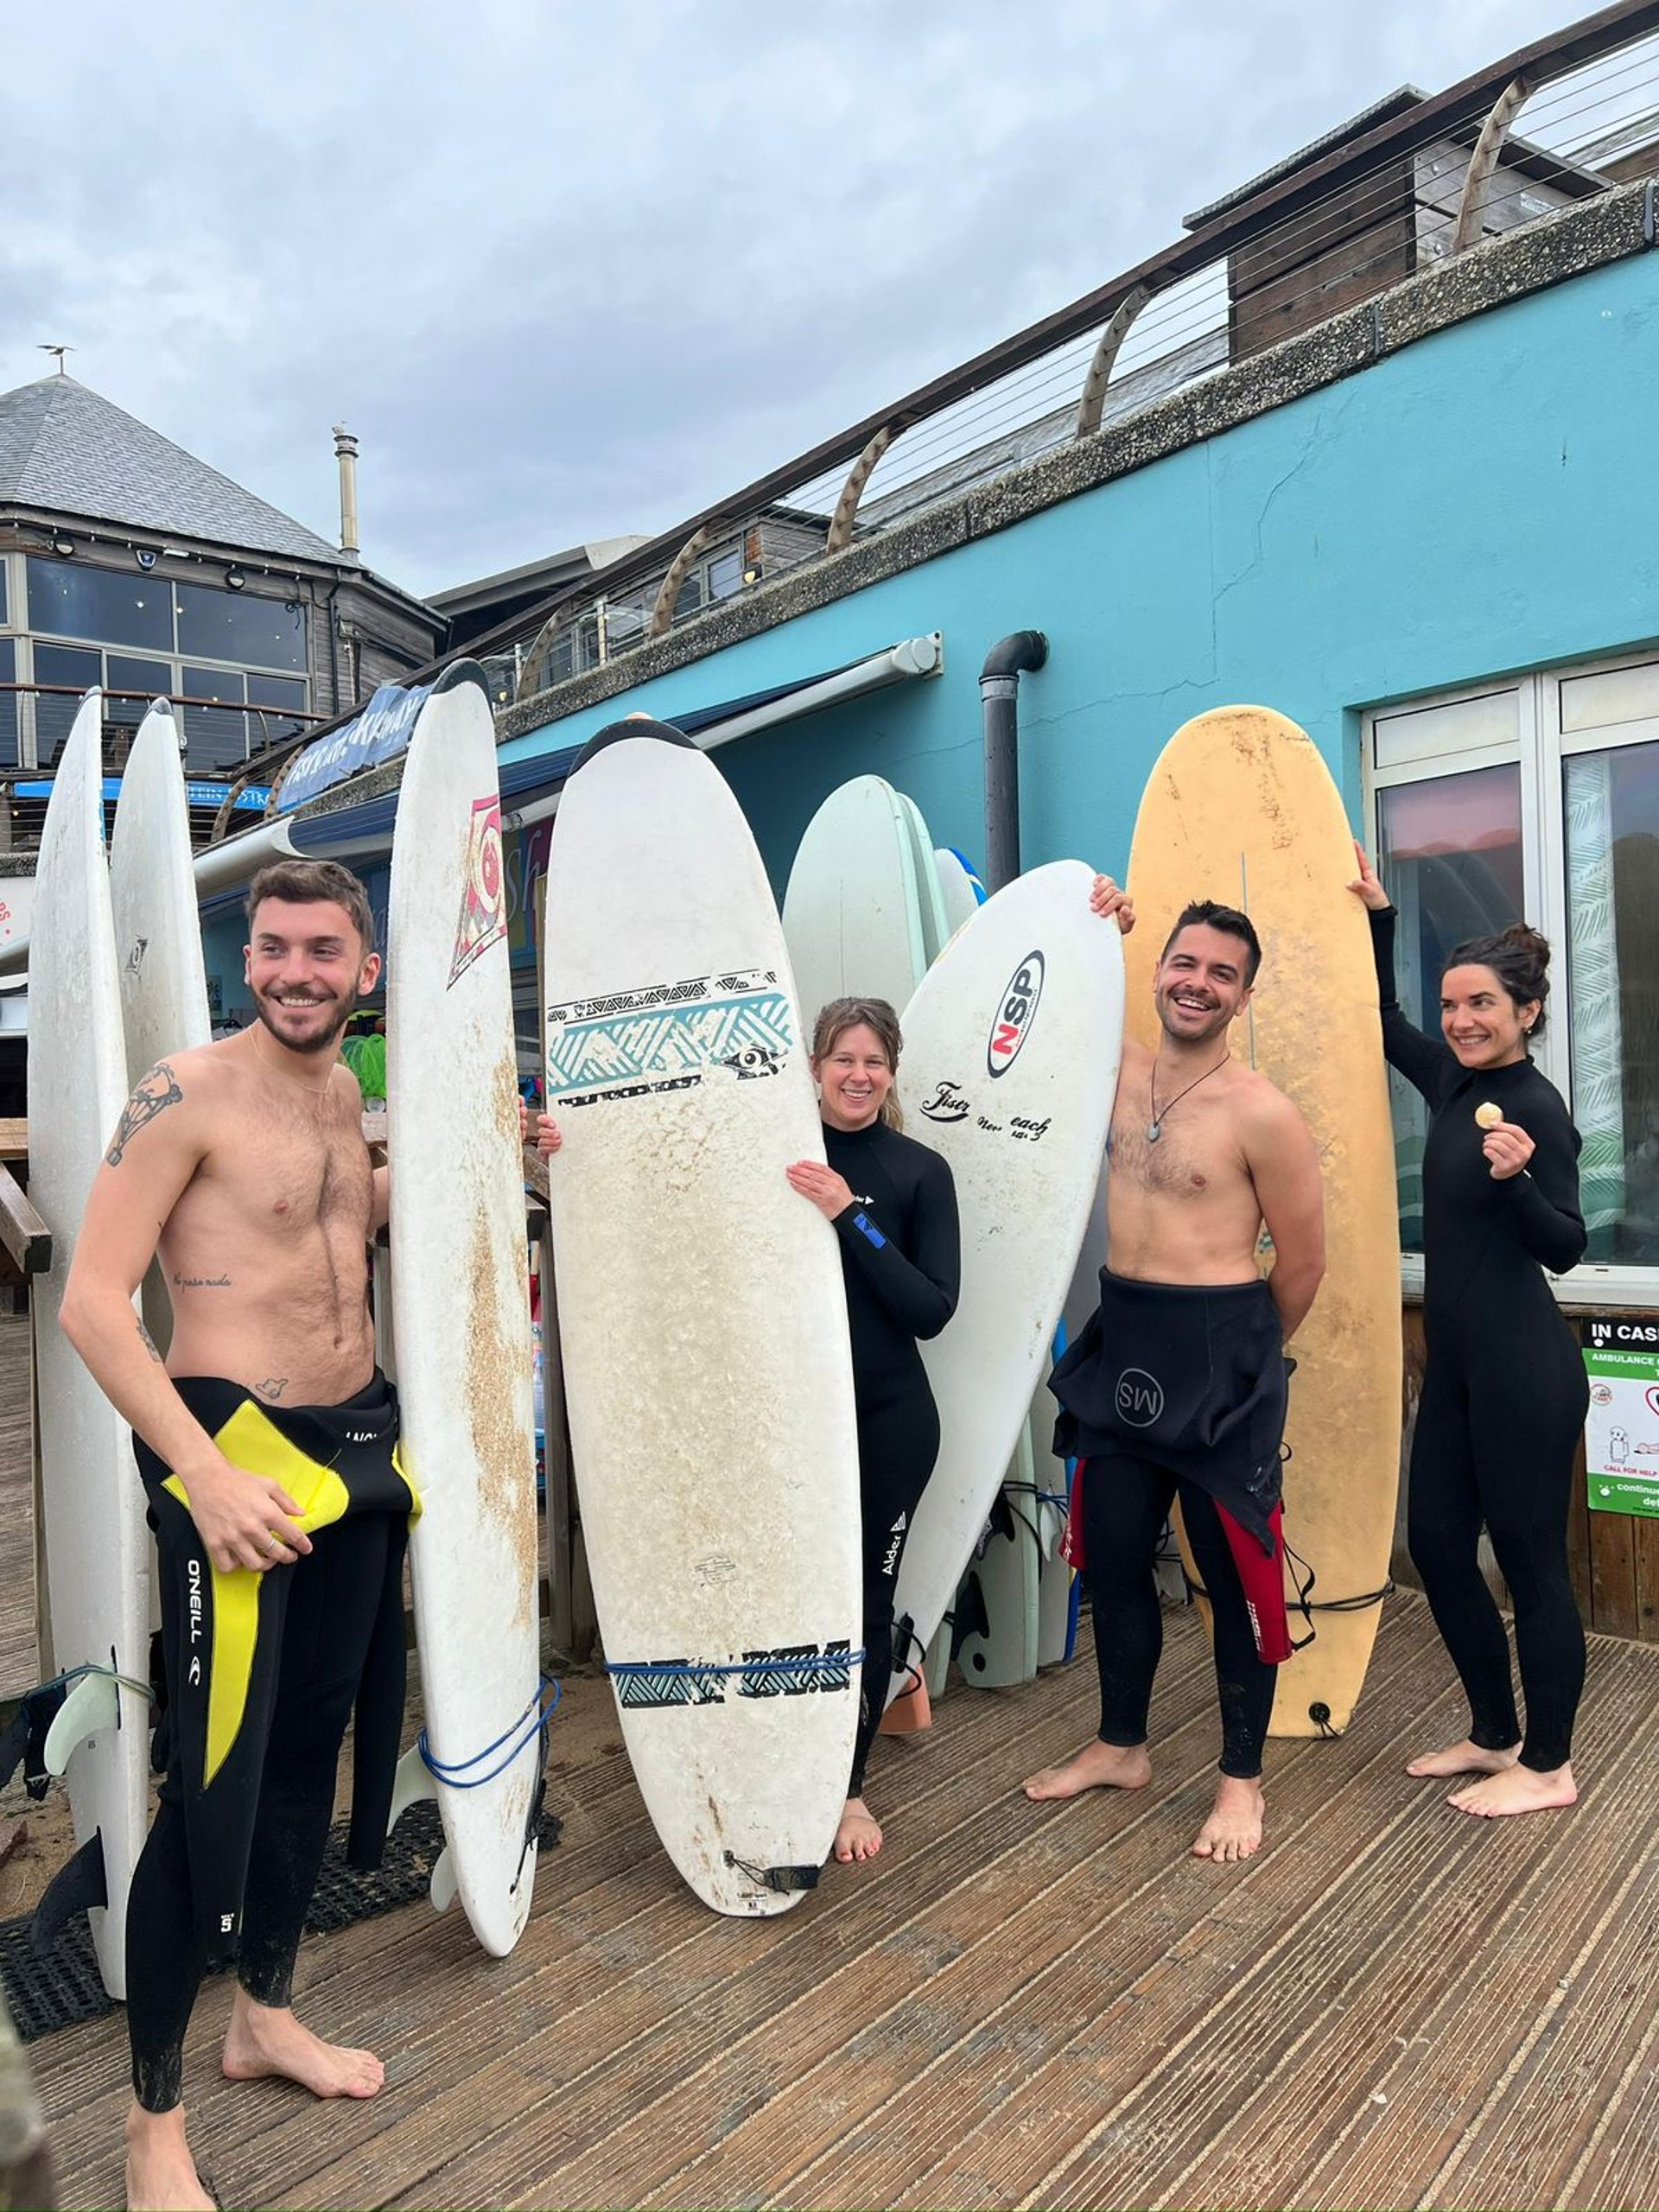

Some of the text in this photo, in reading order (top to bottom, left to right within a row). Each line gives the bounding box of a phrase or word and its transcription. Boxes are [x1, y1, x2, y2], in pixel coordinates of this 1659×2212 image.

[993, 969, 1033, 1055] NSP
[1592, 1324, 1659, 1342] IN CAS
[1592, 1353, 1656, 1366] AMBULANCE
[881, 1535, 901, 1575] Alder
[188, 1559, 202, 1643] O'NEILL
